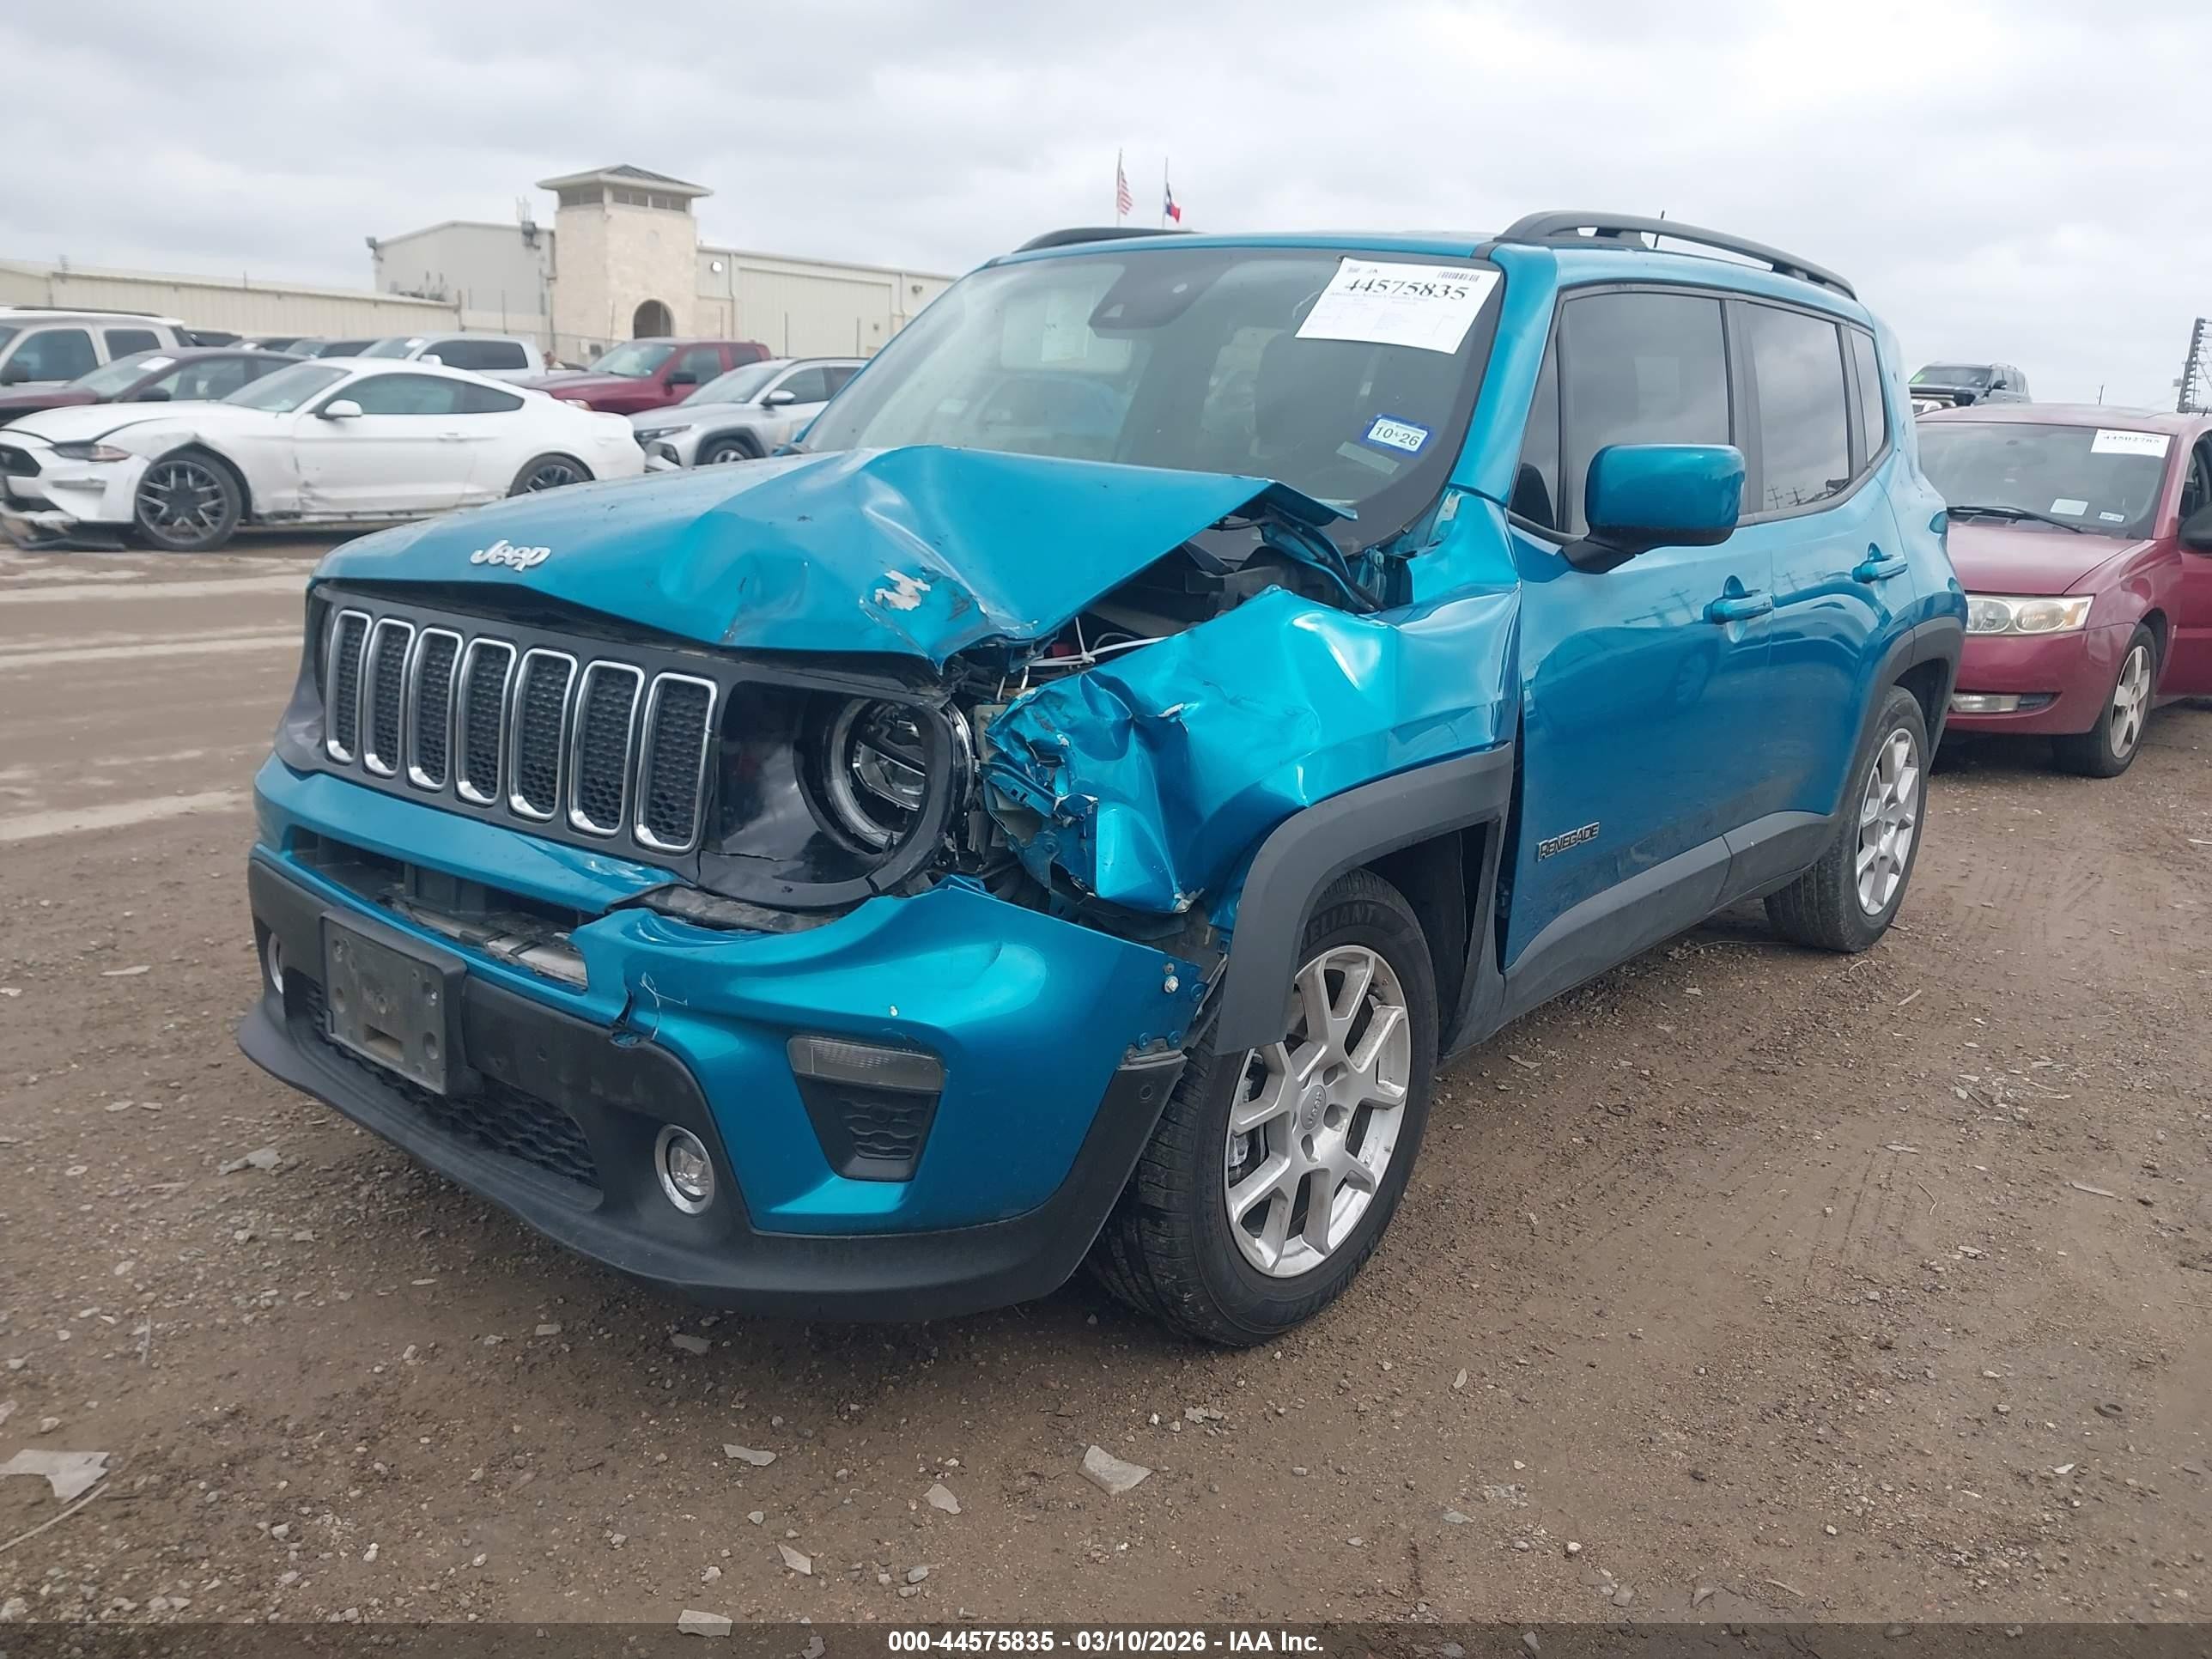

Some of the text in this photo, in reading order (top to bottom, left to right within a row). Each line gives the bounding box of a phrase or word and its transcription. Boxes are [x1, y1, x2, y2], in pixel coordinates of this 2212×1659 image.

[1344, 277, 1469, 301] 44575835
[1376, 426, 1394, 439] 10
[1399, 433, 1420, 447] 26
[470, 539, 551, 573] Jeep
[1538, 822, 1600, 861] RENEGADE
[1304, 903, 1377, 948] ELIANT
